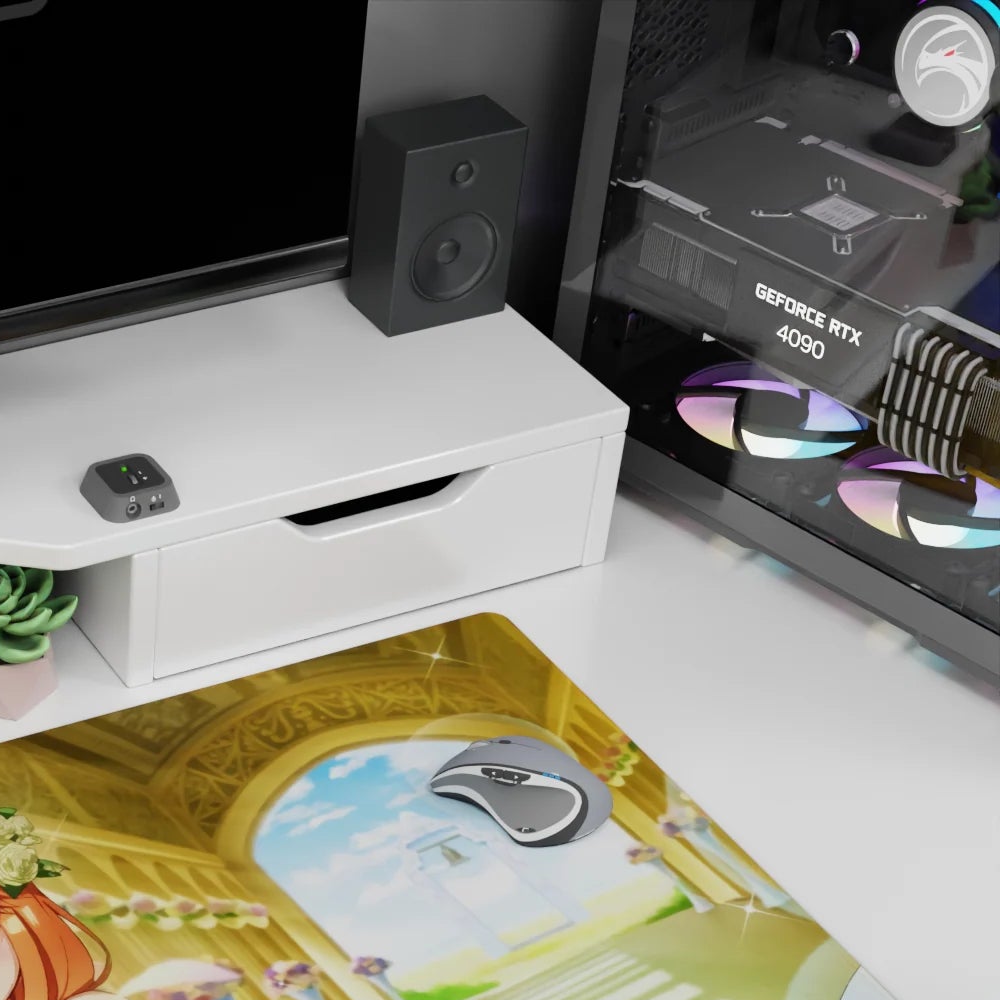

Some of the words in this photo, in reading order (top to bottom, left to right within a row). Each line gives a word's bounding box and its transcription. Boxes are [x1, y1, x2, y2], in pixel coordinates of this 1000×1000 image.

[755, 282, 827, 329] GEFORCE
[828, 317, 863, 347] RTX
[776, 325, 826, 360] 4090
